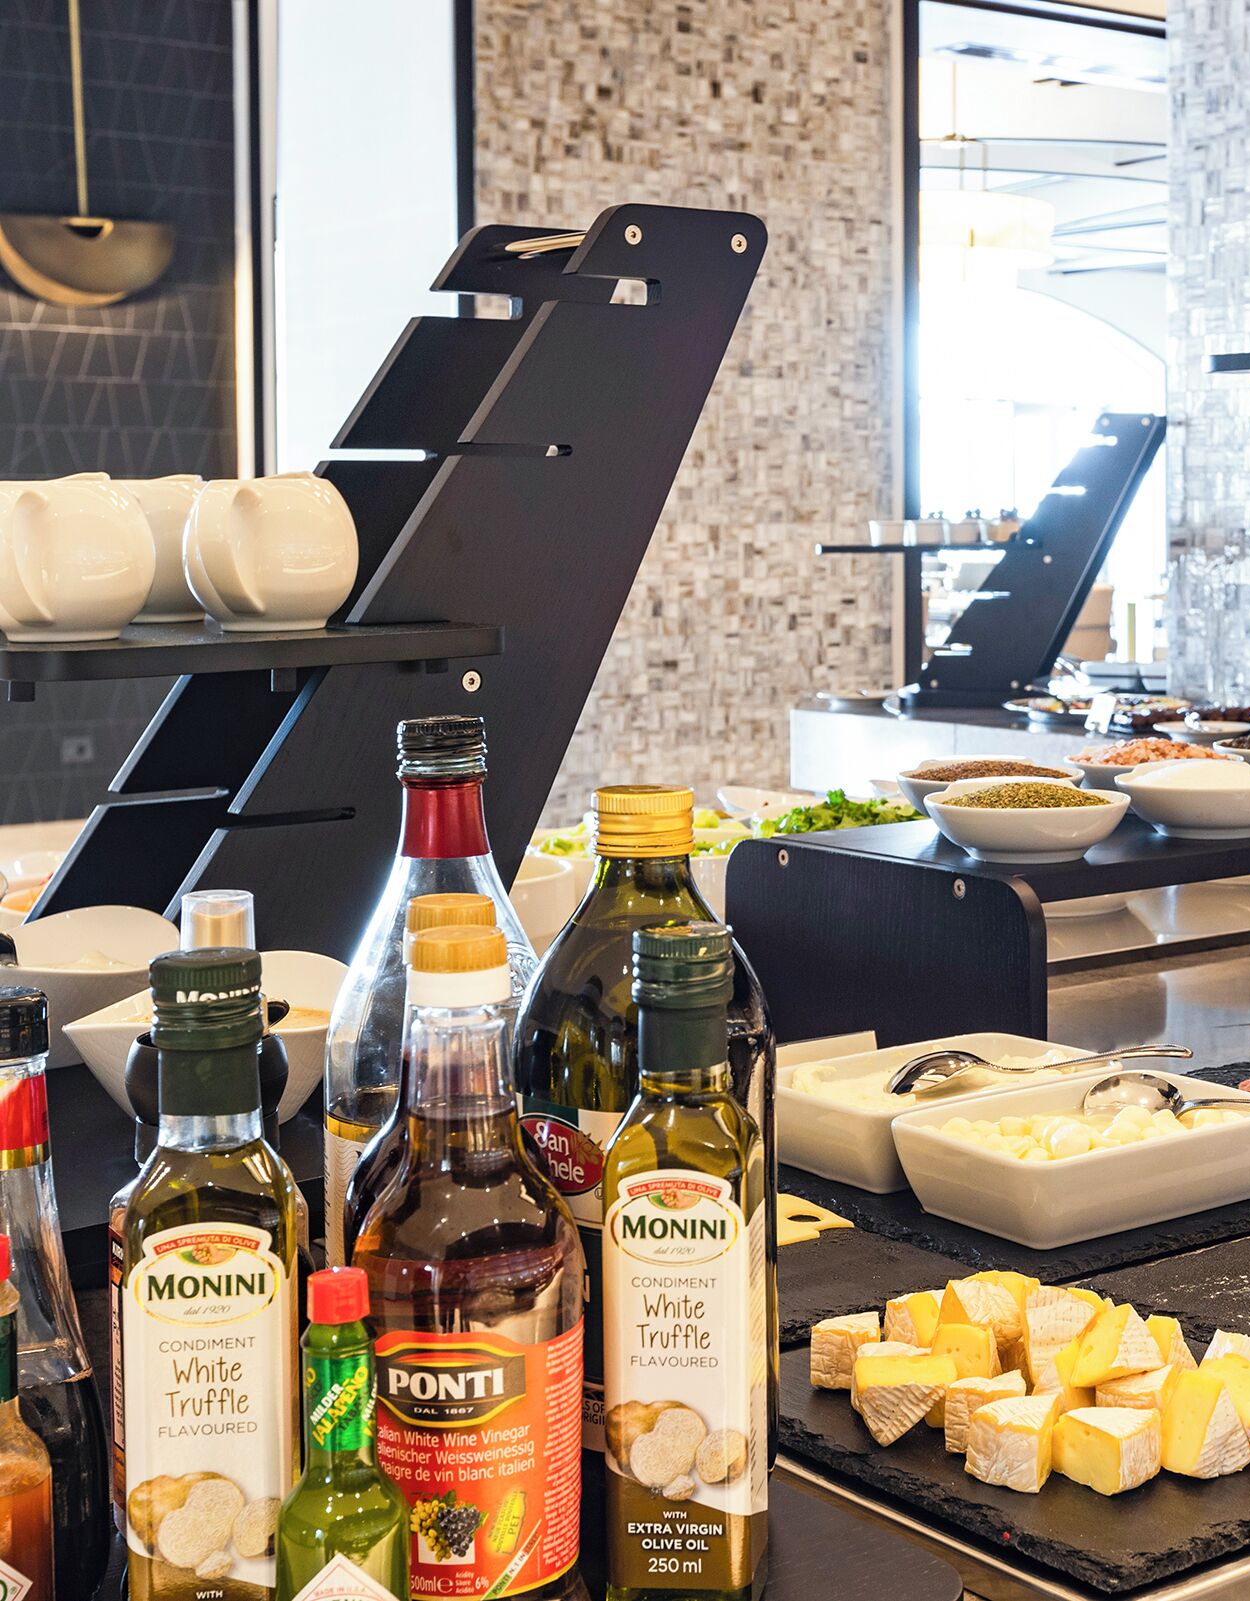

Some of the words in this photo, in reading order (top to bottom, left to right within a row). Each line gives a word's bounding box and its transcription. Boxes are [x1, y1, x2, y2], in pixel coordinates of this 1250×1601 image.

[534, 1121, 570, 1156] San
[696, 1185, 718, 1196] OLIVE
[622, 1215, 726, 1240] MONINI
[233, 1237, 257, 1249] OLIVE
[653, 1246, 669, 1255] dal
[670, 1246, 696, 1256] 1920
[147, 1273, 266, 1301] MONINI
[631, 1277, 717, 1289] CONDIMENT
[183, 1306, 201, 1316] dal
[202, 1304, 232, 1315] 1920
[643, 1292, 705, 1319] White
[158, 1336, 256, 1353] CONDIMENT
[636, 1323, 711, 1350] Truffle
[172, 1356, 243, 1384] White
[630, 1355, 719, 1368] FLAVOURED
[388, 1367, 504, 1400] PONTI
[164, 1387, 249, 1417] Truffle
[310, 1383, 344, 1425] MILDER
[413, 1407, 438, 1415] DAL
[158, 1421, 258, 1438] FLAVOURED
[403, 1430, 439, 1448] White
[443, 1432, 477, 1448] Wine
[481, 1424, 531, 1446] Vinegar
[435, 1440, 535, 1465] Weissweinessig
[415, 1466, 431, 1482] de
[434, 1468, 454, 1482] vin
[458, 1465, 495, 1482] blanc
[499, 1456, 535, 1477] italien
[663, 1511, 687, 1519] WITH
[508, 1514, 520, 1535] PET
[627, 1522, 673, 1534] EXTRA
[676, 1523, 723, 1536] VIRGIN
[641, 1538, 683, 1550] OLIVE
[685, 1539, 709, 1551] OIL
[648, 1557, 680, 1573] 250
[682, 1558, 702, 1573] ml
[475, 1576, 490, 1590] 6%
[196, 1590, 224, 1600] WITH
